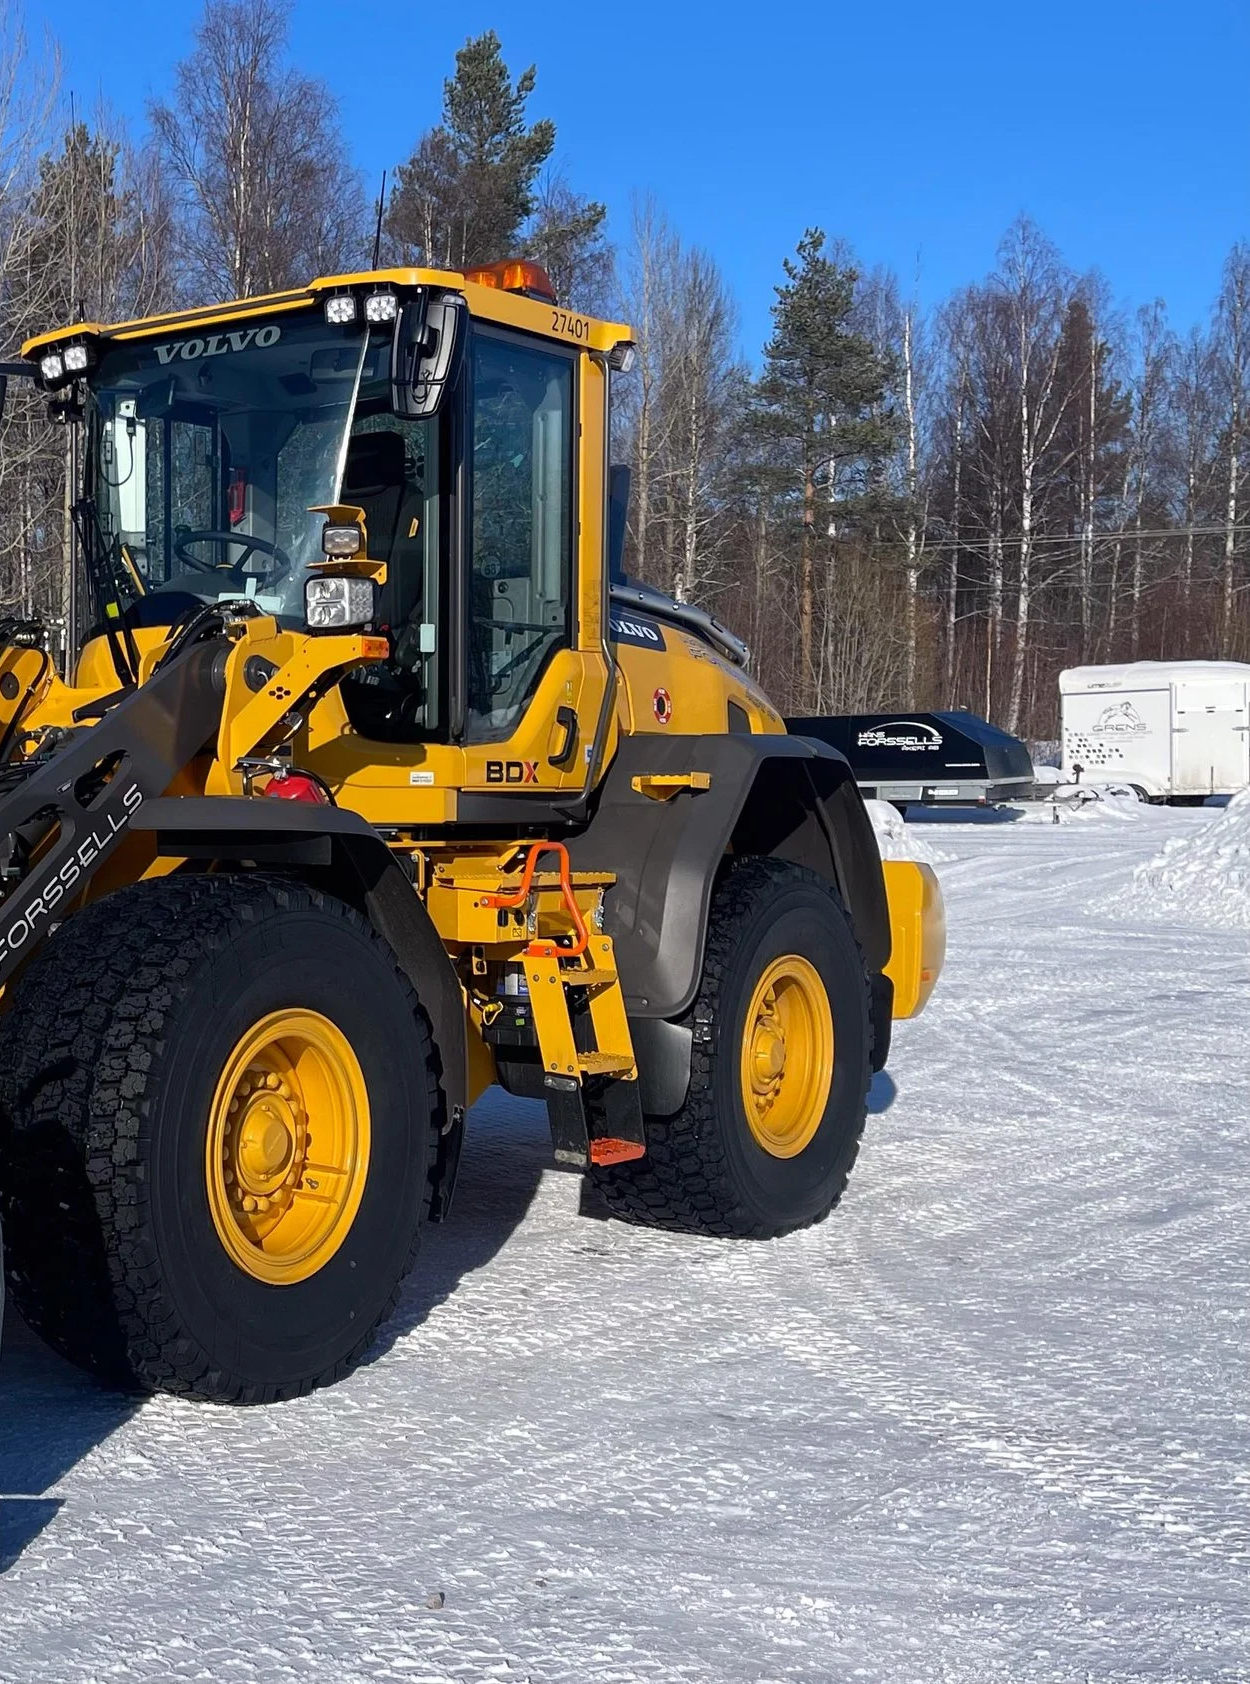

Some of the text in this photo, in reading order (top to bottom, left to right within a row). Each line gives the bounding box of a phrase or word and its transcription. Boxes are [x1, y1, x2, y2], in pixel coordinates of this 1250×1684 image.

[552, 311, 589, 341] 27401
[153, 325, 281, 365] VOLVO
[609, 618, 659, 641] OLVO
[1092, 723, 1147, 732] GRENS
[857, 736, 943, 746] FORSSELLS
[486, 760, 540, 783] BDX
